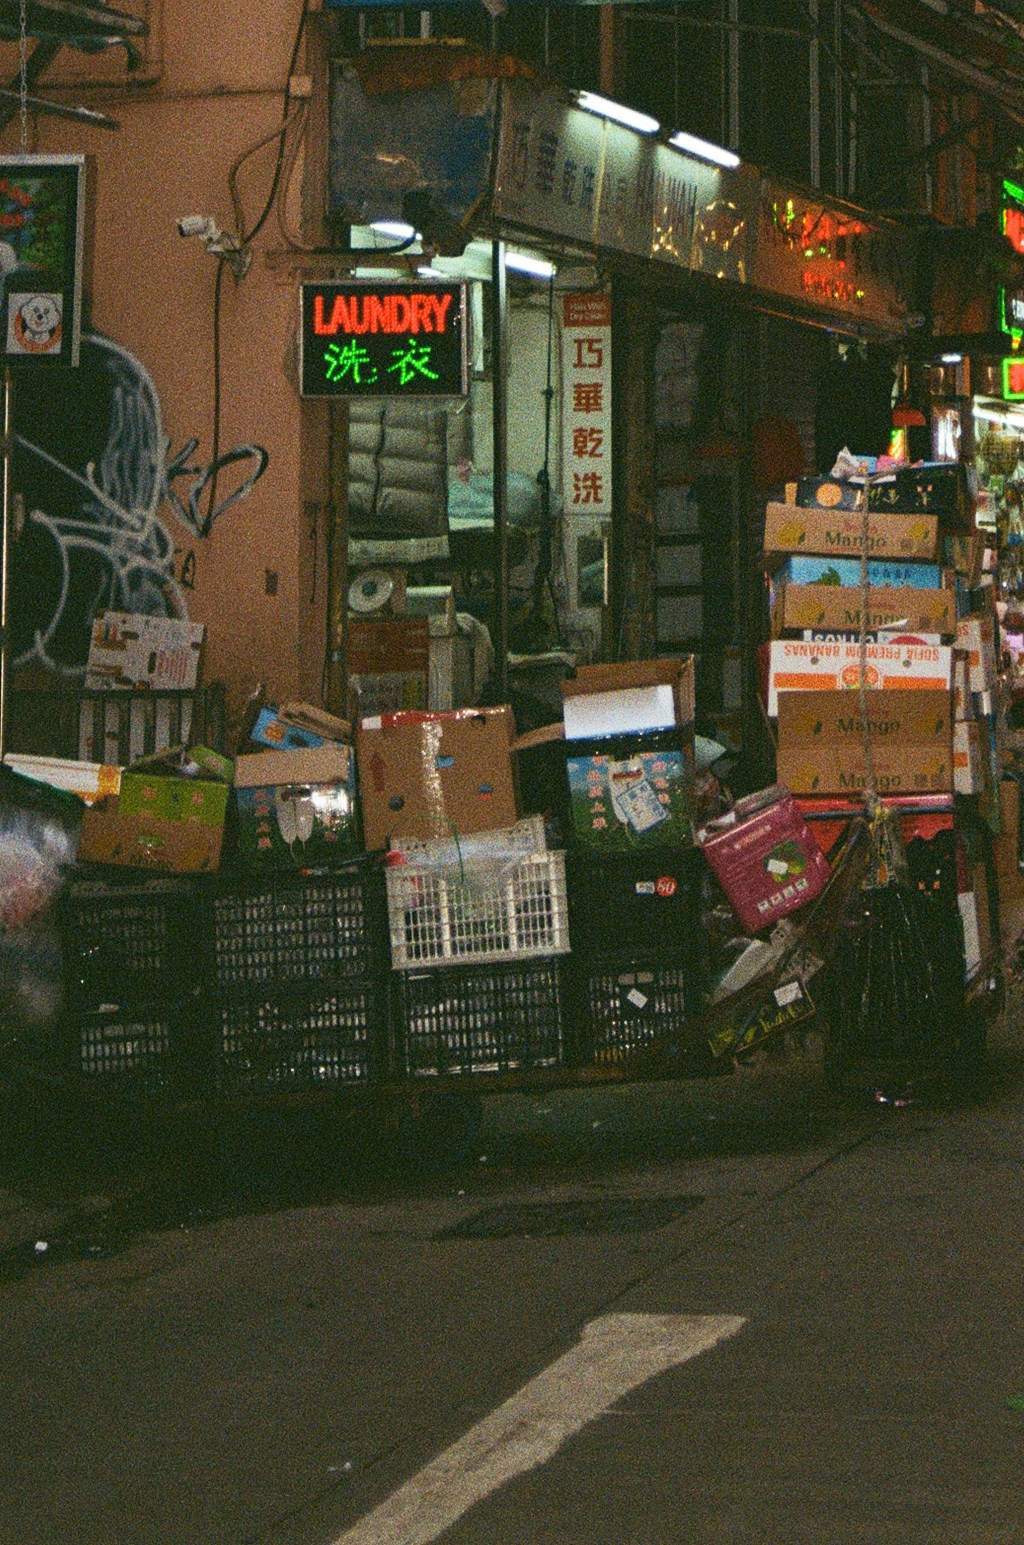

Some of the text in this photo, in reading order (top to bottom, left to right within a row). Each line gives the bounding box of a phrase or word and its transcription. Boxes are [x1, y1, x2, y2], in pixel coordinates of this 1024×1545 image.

[313, 293, 452, 335] LAUNDRY
[324, 338, 439, 385] 洗衣
[572, 337, 604, 506] 巧華乾洗
[844, 610, 900, 626] Mang
[784, 643, 940, 662] SOFIA PREMUM BANANAS
